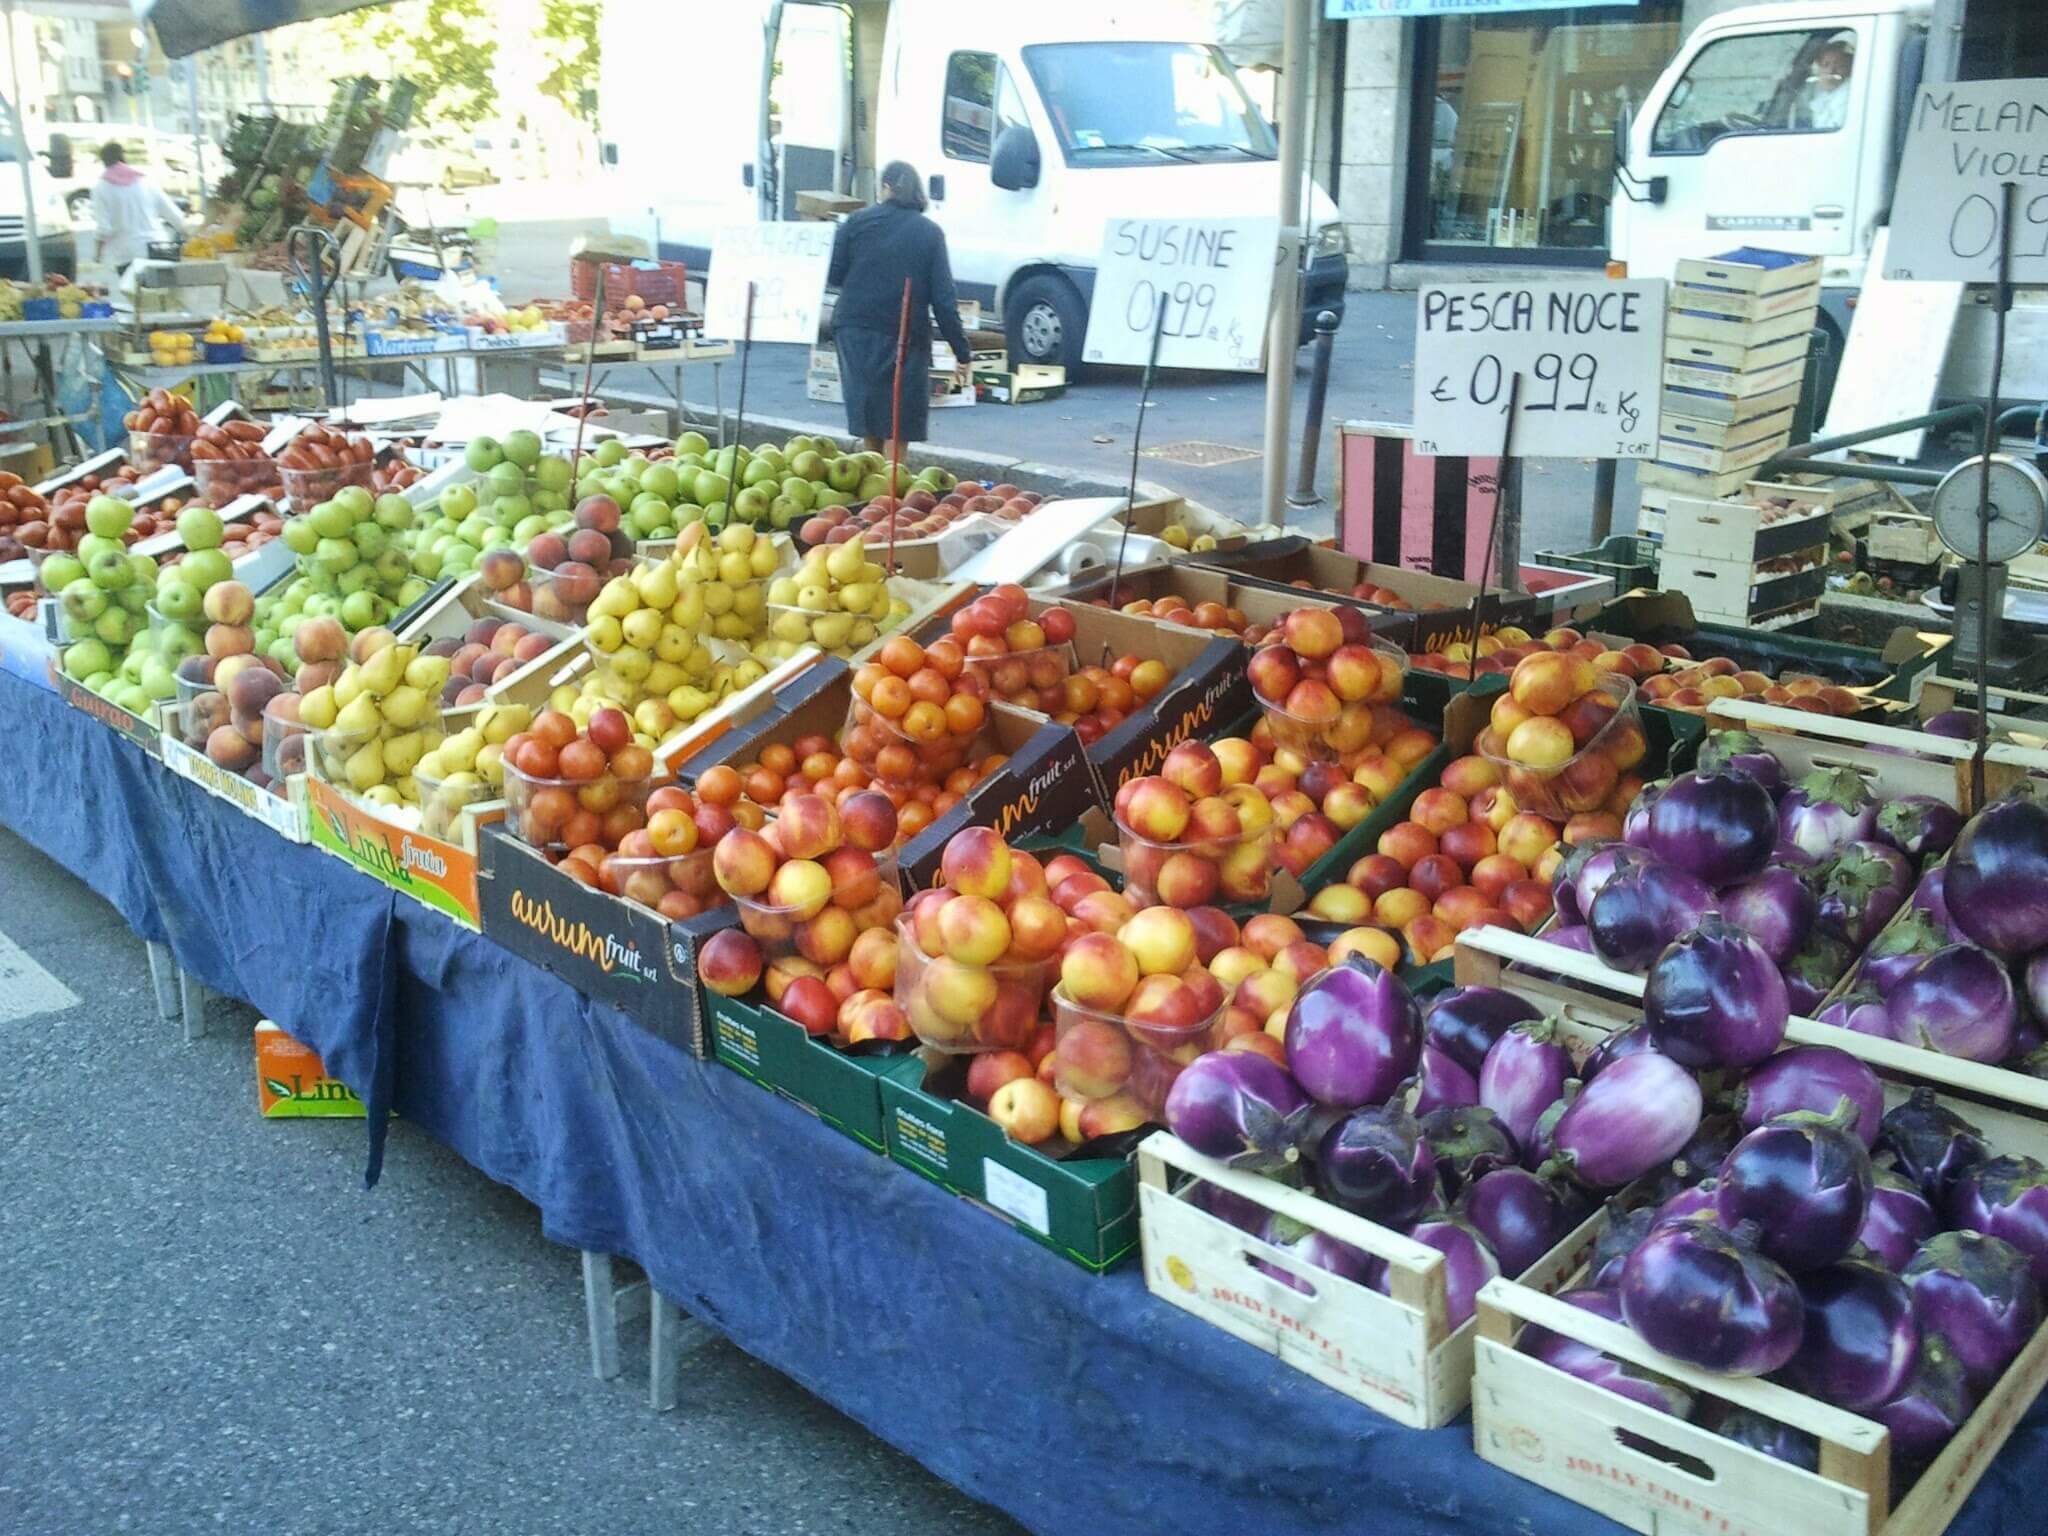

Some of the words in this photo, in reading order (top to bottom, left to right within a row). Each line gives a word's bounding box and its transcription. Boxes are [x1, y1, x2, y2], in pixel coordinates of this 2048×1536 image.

[1114, 220, 1238, 268] SUSINE
[1894, 269, 1913, 280] ITA
[1126, 279, 1216, 338] 099
[1425, 290, 1533, 332] PESCA
[1548, 292, 1641, 334] NOCE
[1430, 376, 1456, 402] €
[1617, 391, 1641, 433] Kg
[1419, 441, 1438, 453] ITA
[1628, 443, 1650, 454] CAT
[1205, 672, 1232, 711] fruit
[1029, 760, 1062, 802] fruit
[340, 810, 413, 885] Linda
[401, 834, 448, 878] fruta
[511, 889, 614, 972] aurum
[605, 933, 643, 972] fruit
[291, 1074, 360, 1101] Lin
[1566, 1456, 1635, 1487] JOLLY
